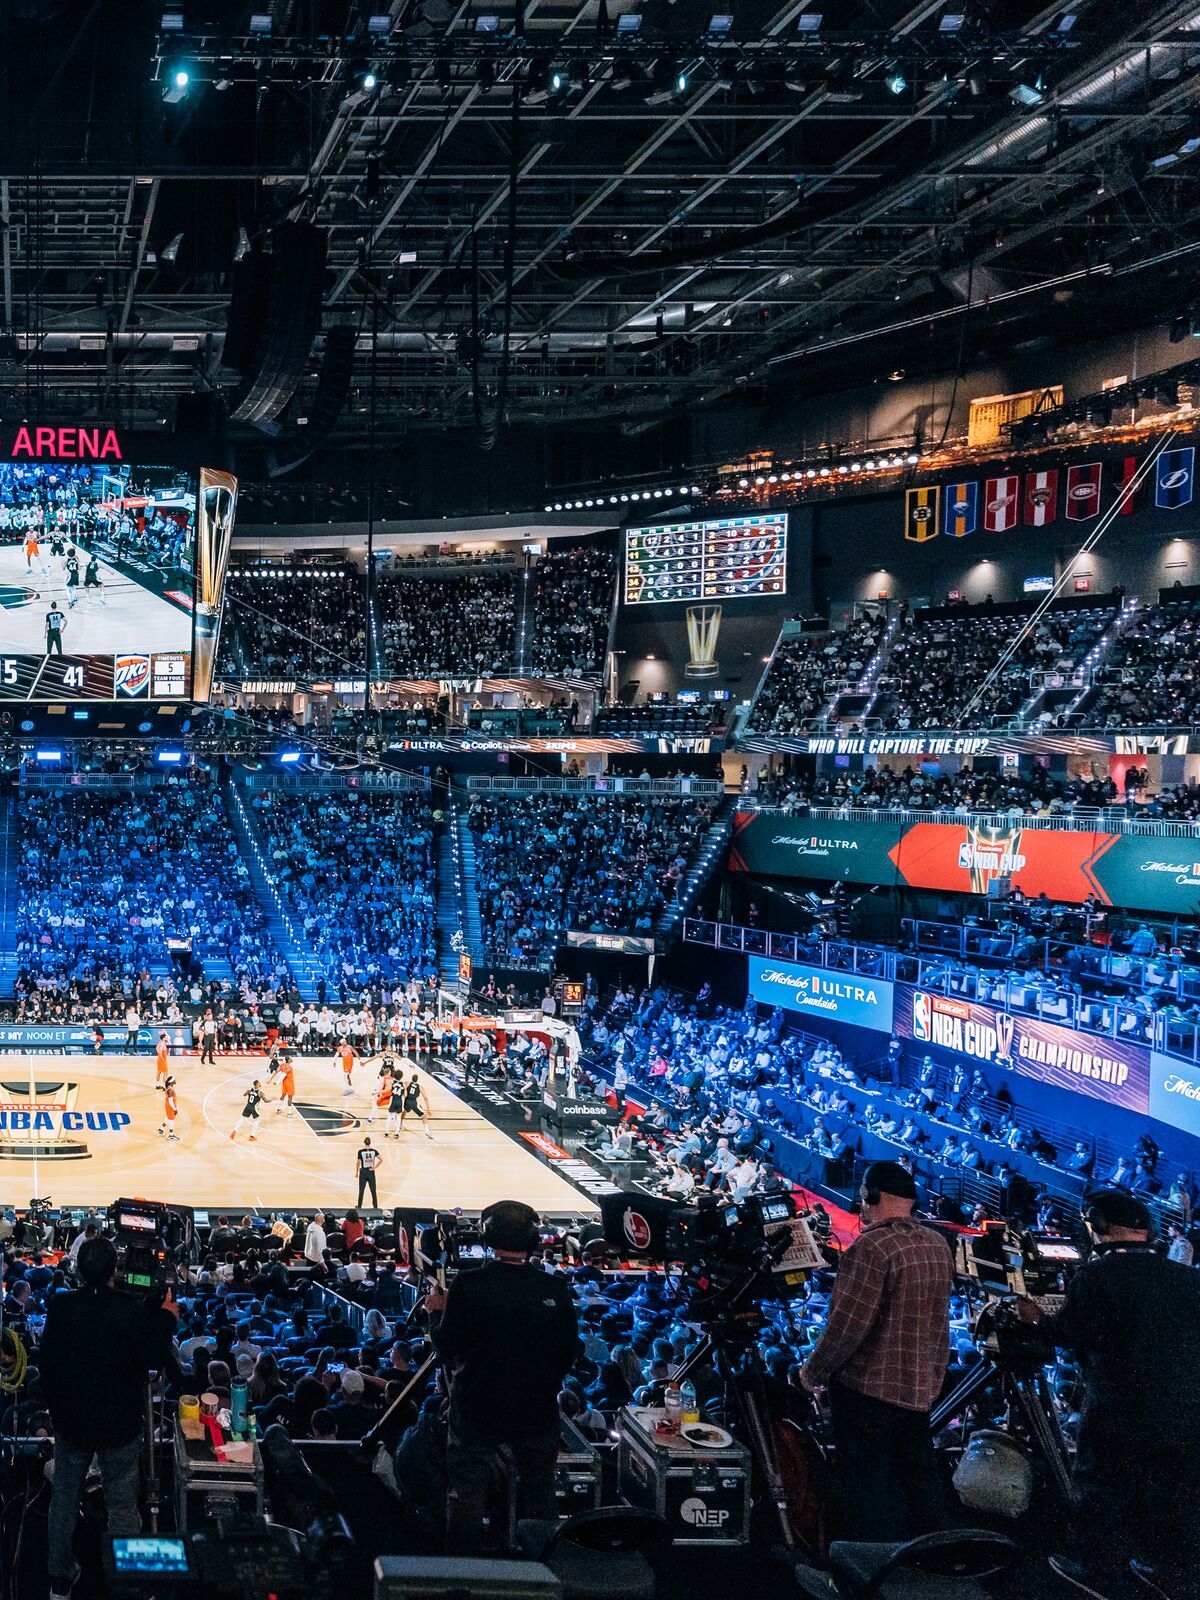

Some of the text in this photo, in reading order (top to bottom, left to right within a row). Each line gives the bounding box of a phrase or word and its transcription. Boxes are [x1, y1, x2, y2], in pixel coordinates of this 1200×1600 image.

[11, 426, 122, 459] ARENA
[168, 662, 174, 673] 5
[63, 666, 84, 687] 41
[241, 681, 296, 694] CHAMPIONSHIP
[411, 741, 443, 750] ULTRA
[471, 741, 503, 750] Copilot
[808, 738, 990, 754] WHO WILL CAPTURE THE CUP?
[818, 838, 858, 850] ULTRA
[974, 852, 1026, 873] NBA CUP
[1140, 861, 1192, 873] Michelob
[760, 969, 878, 1005] Michelob ULTRA
[796, 990, 838, 1011] Courtside
[935, 1000, 967, 1017] Emirates
[7, 1031, 23, 1041] DAY
[26, 1031, 54, 1041] NOON
[55, 1031, 67, 1041] ET
[932, 1011, 1129, 1087] NBA CUP CHAMPIONSHIP
[563, 1104, 607, 1115] coinbase
[62, 1111, 131, 1131] CUP
[695, 1510, 730, 1524] NEP
